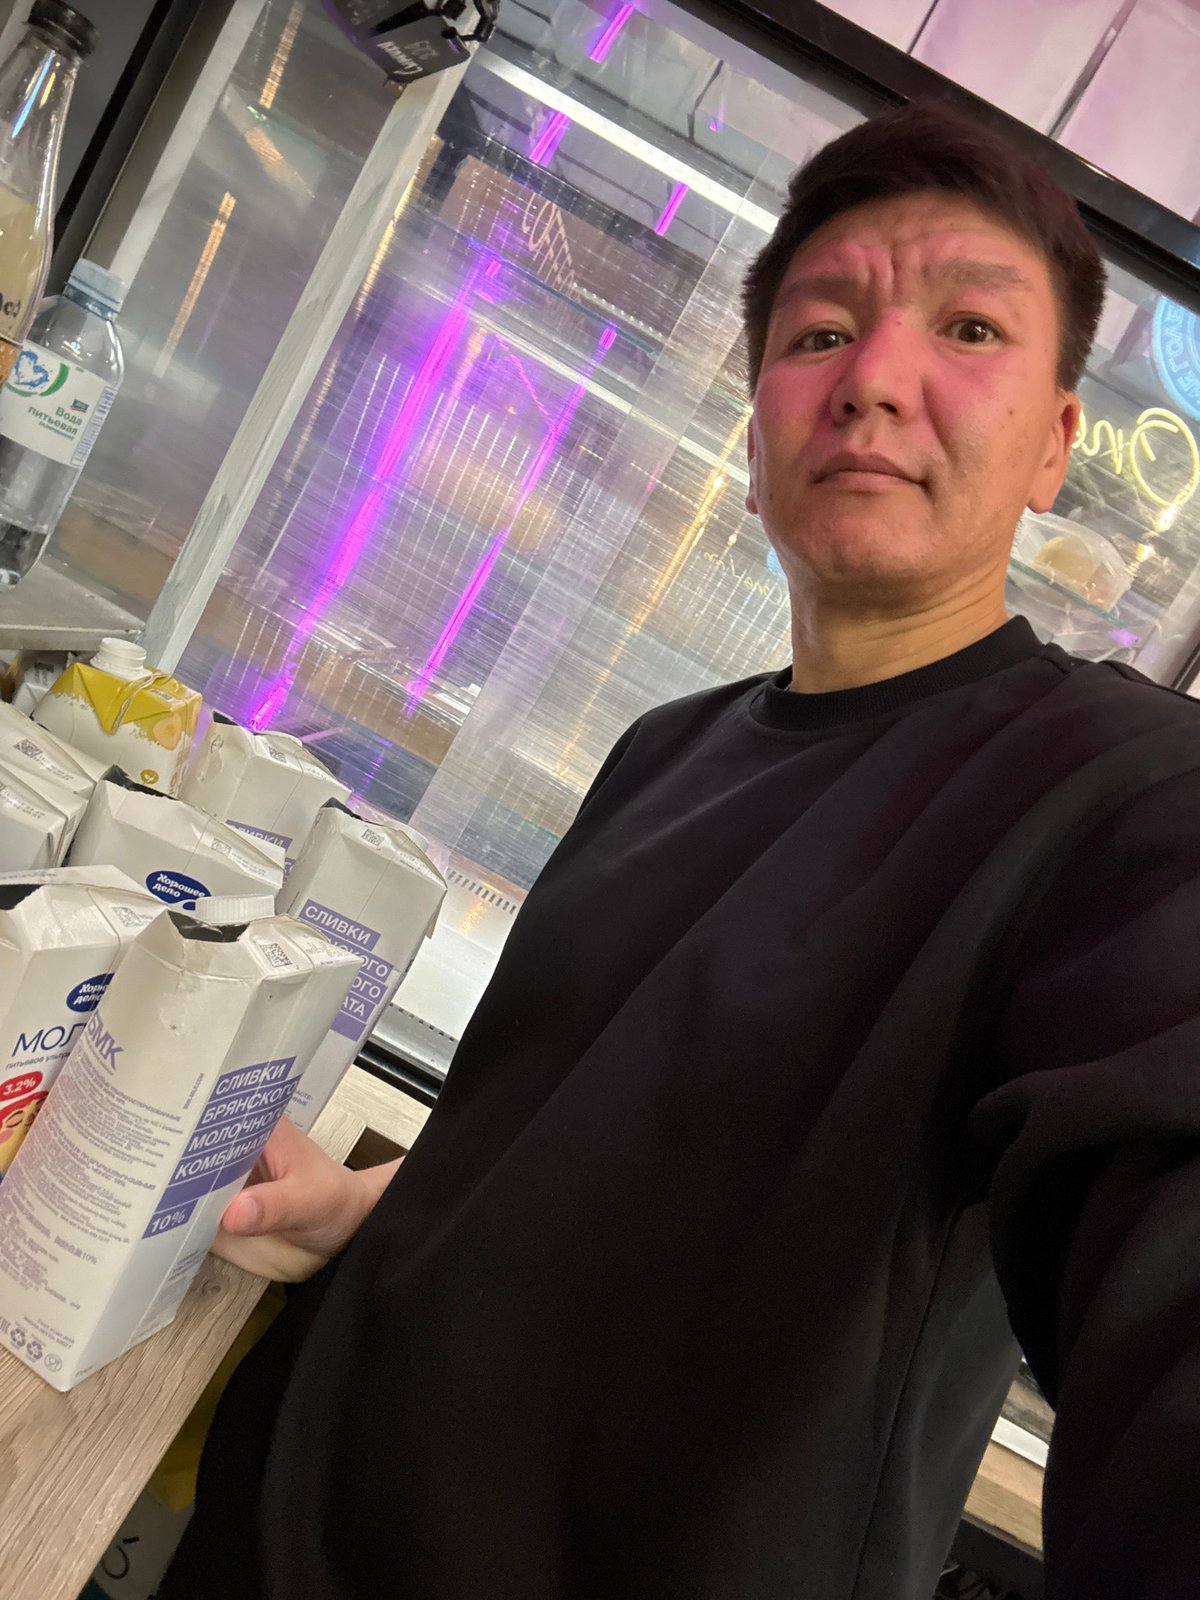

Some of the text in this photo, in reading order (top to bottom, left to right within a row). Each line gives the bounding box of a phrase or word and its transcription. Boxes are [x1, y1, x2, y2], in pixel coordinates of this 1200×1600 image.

[27, 406, 79, 435] питьевая
[55, 406, 83, 426] Вода
[152, 883, 181, 898] дело
[157, 873, 206, 897] Хорошее
[305, 905, 371, 945] СЛИВКИ
[11, 1022, 88, 1057] МОЛ
[3, 1077, 36, 1096] 3.2%
[215, 1063, 287, 1096] СЛИВКИ
[202, 1080, 297, 1124] БРЯНСКОГО
[188, 1108, 281, 1152] МОЛОЧНОГ
[151, 1208, 187, 1233] 10%
